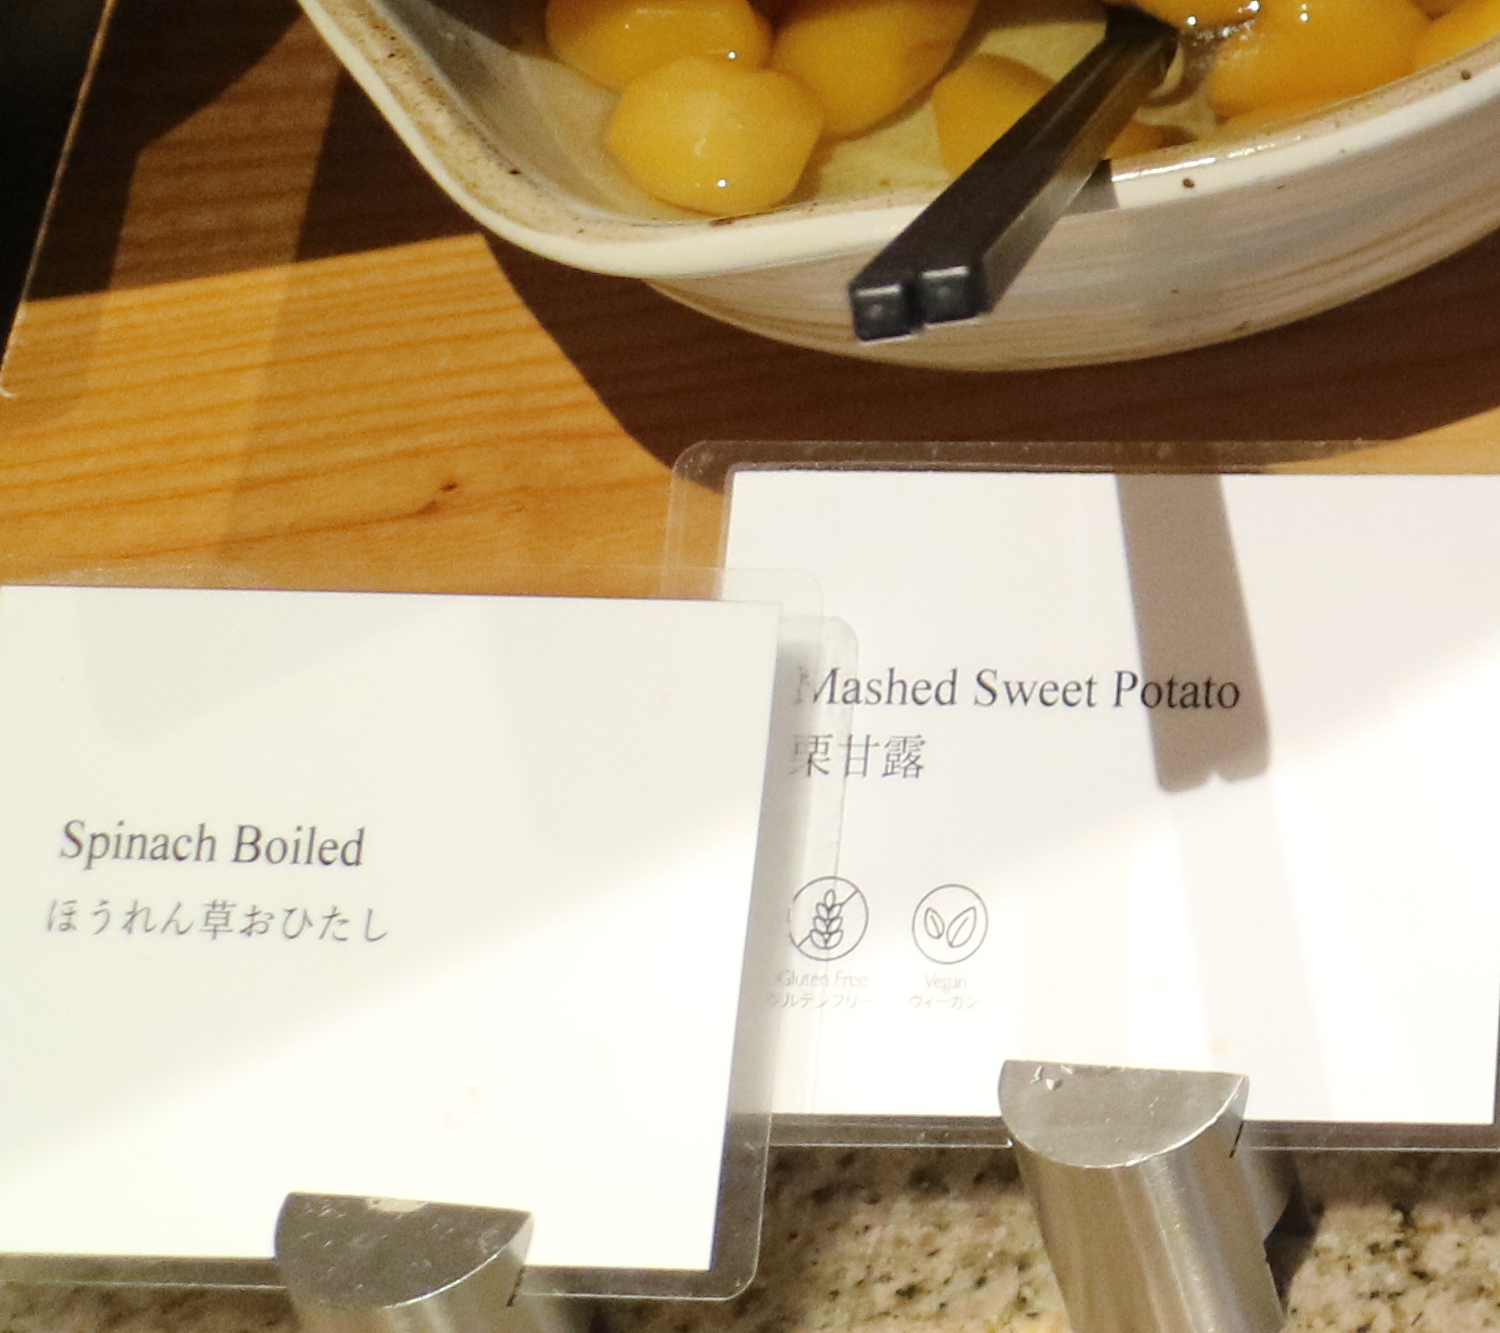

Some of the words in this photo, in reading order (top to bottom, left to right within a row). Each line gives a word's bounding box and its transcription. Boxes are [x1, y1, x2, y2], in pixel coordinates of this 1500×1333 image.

[795, 666, 957, 707] Mashed
[974, 669, 1098, 709] Sweet
[1112, 670, 1241, 710] Potato
[789, 734, 926, 779] 栗甘露
[59, 818, 217, 870] Spinach
[231, 824, 366, 867] Boiled
[46, 895, 389, 945] ほうれん草おひたし
[924, 973, 968, 993] Vegan
